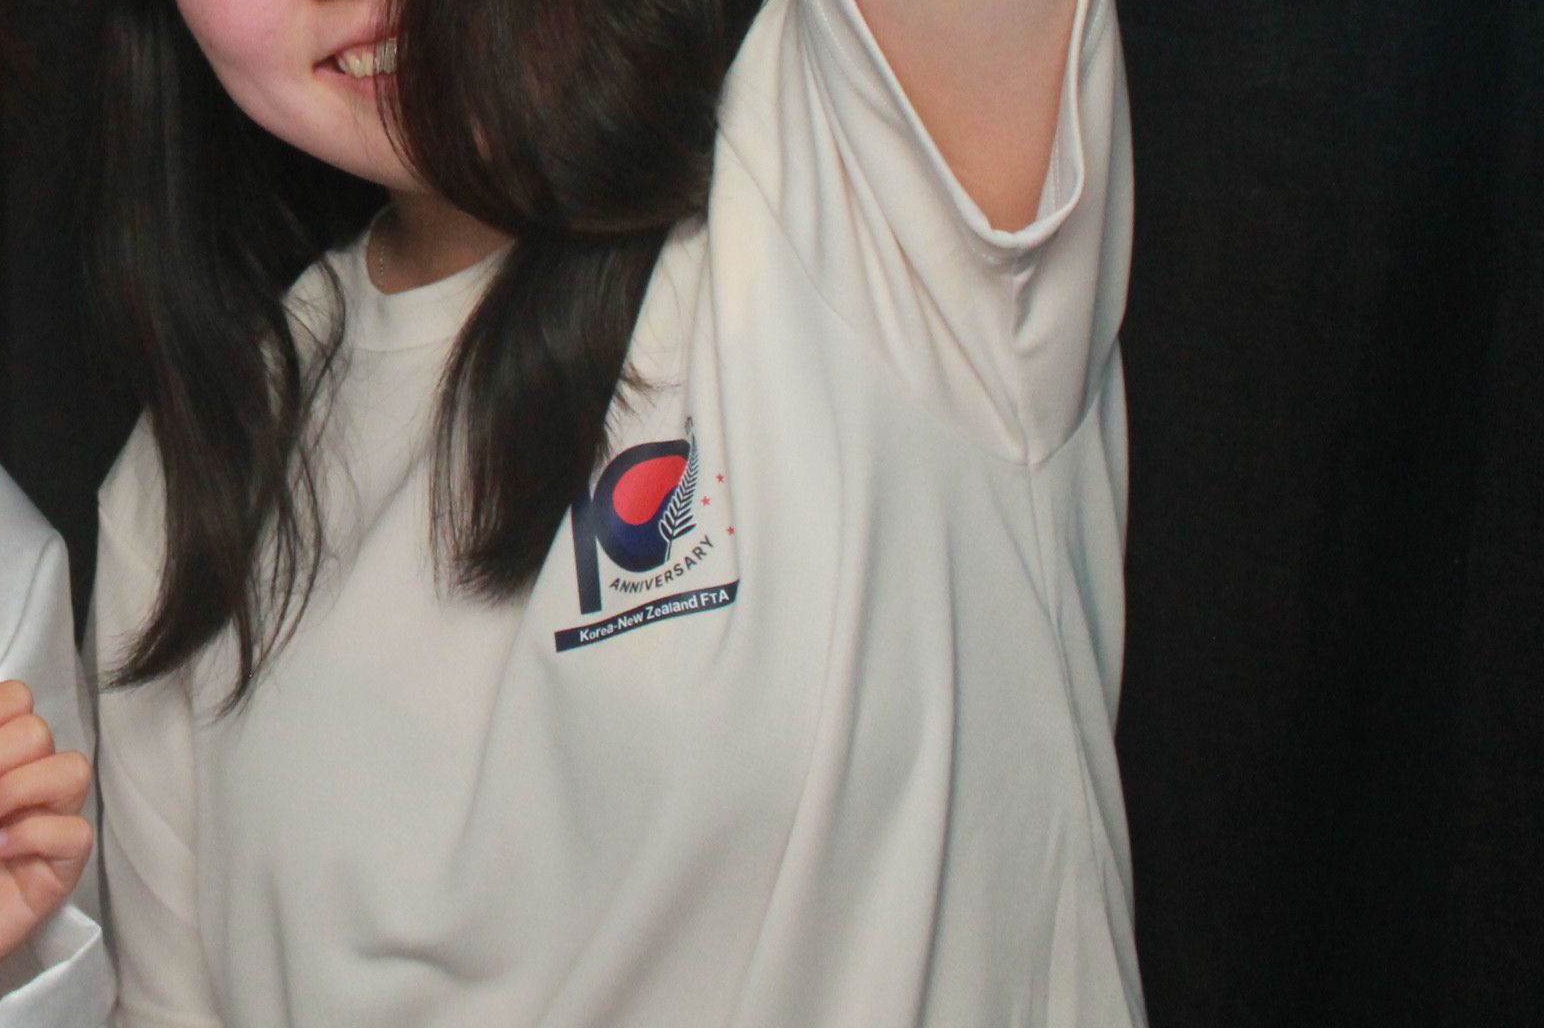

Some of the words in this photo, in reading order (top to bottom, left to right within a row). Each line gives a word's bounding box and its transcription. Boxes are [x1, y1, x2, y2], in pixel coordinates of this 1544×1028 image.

[608, 534, 714, 594] ANNIVERSARY
[578, 611, 644, 643] Korea-New
[645, 594, 698, 620] Zealand
[700, 588, 730, 607] FTA
